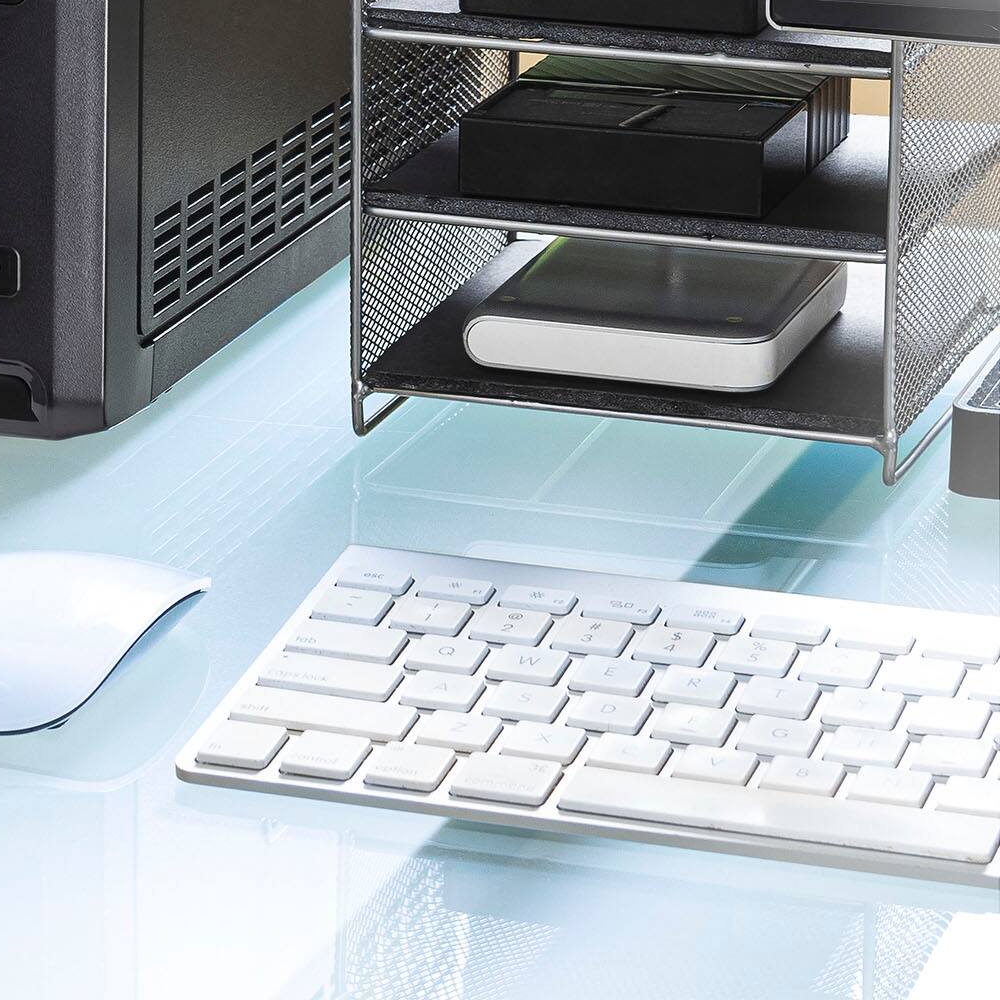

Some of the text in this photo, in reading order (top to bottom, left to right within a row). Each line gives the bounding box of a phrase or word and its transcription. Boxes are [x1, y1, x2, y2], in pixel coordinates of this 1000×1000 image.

[364, 571, 385, 580] esc
[501, 623, 514, 632] 2
[581, 634, 594, 643] 3
[438, 646, 455, 657] Q
[518, 655, 541, 666] W
[604, 666, 616, 677] E
[687, 678, 701, 688] R
[601, 704, 617, 714] D
[772, 728, 790, 739] G
